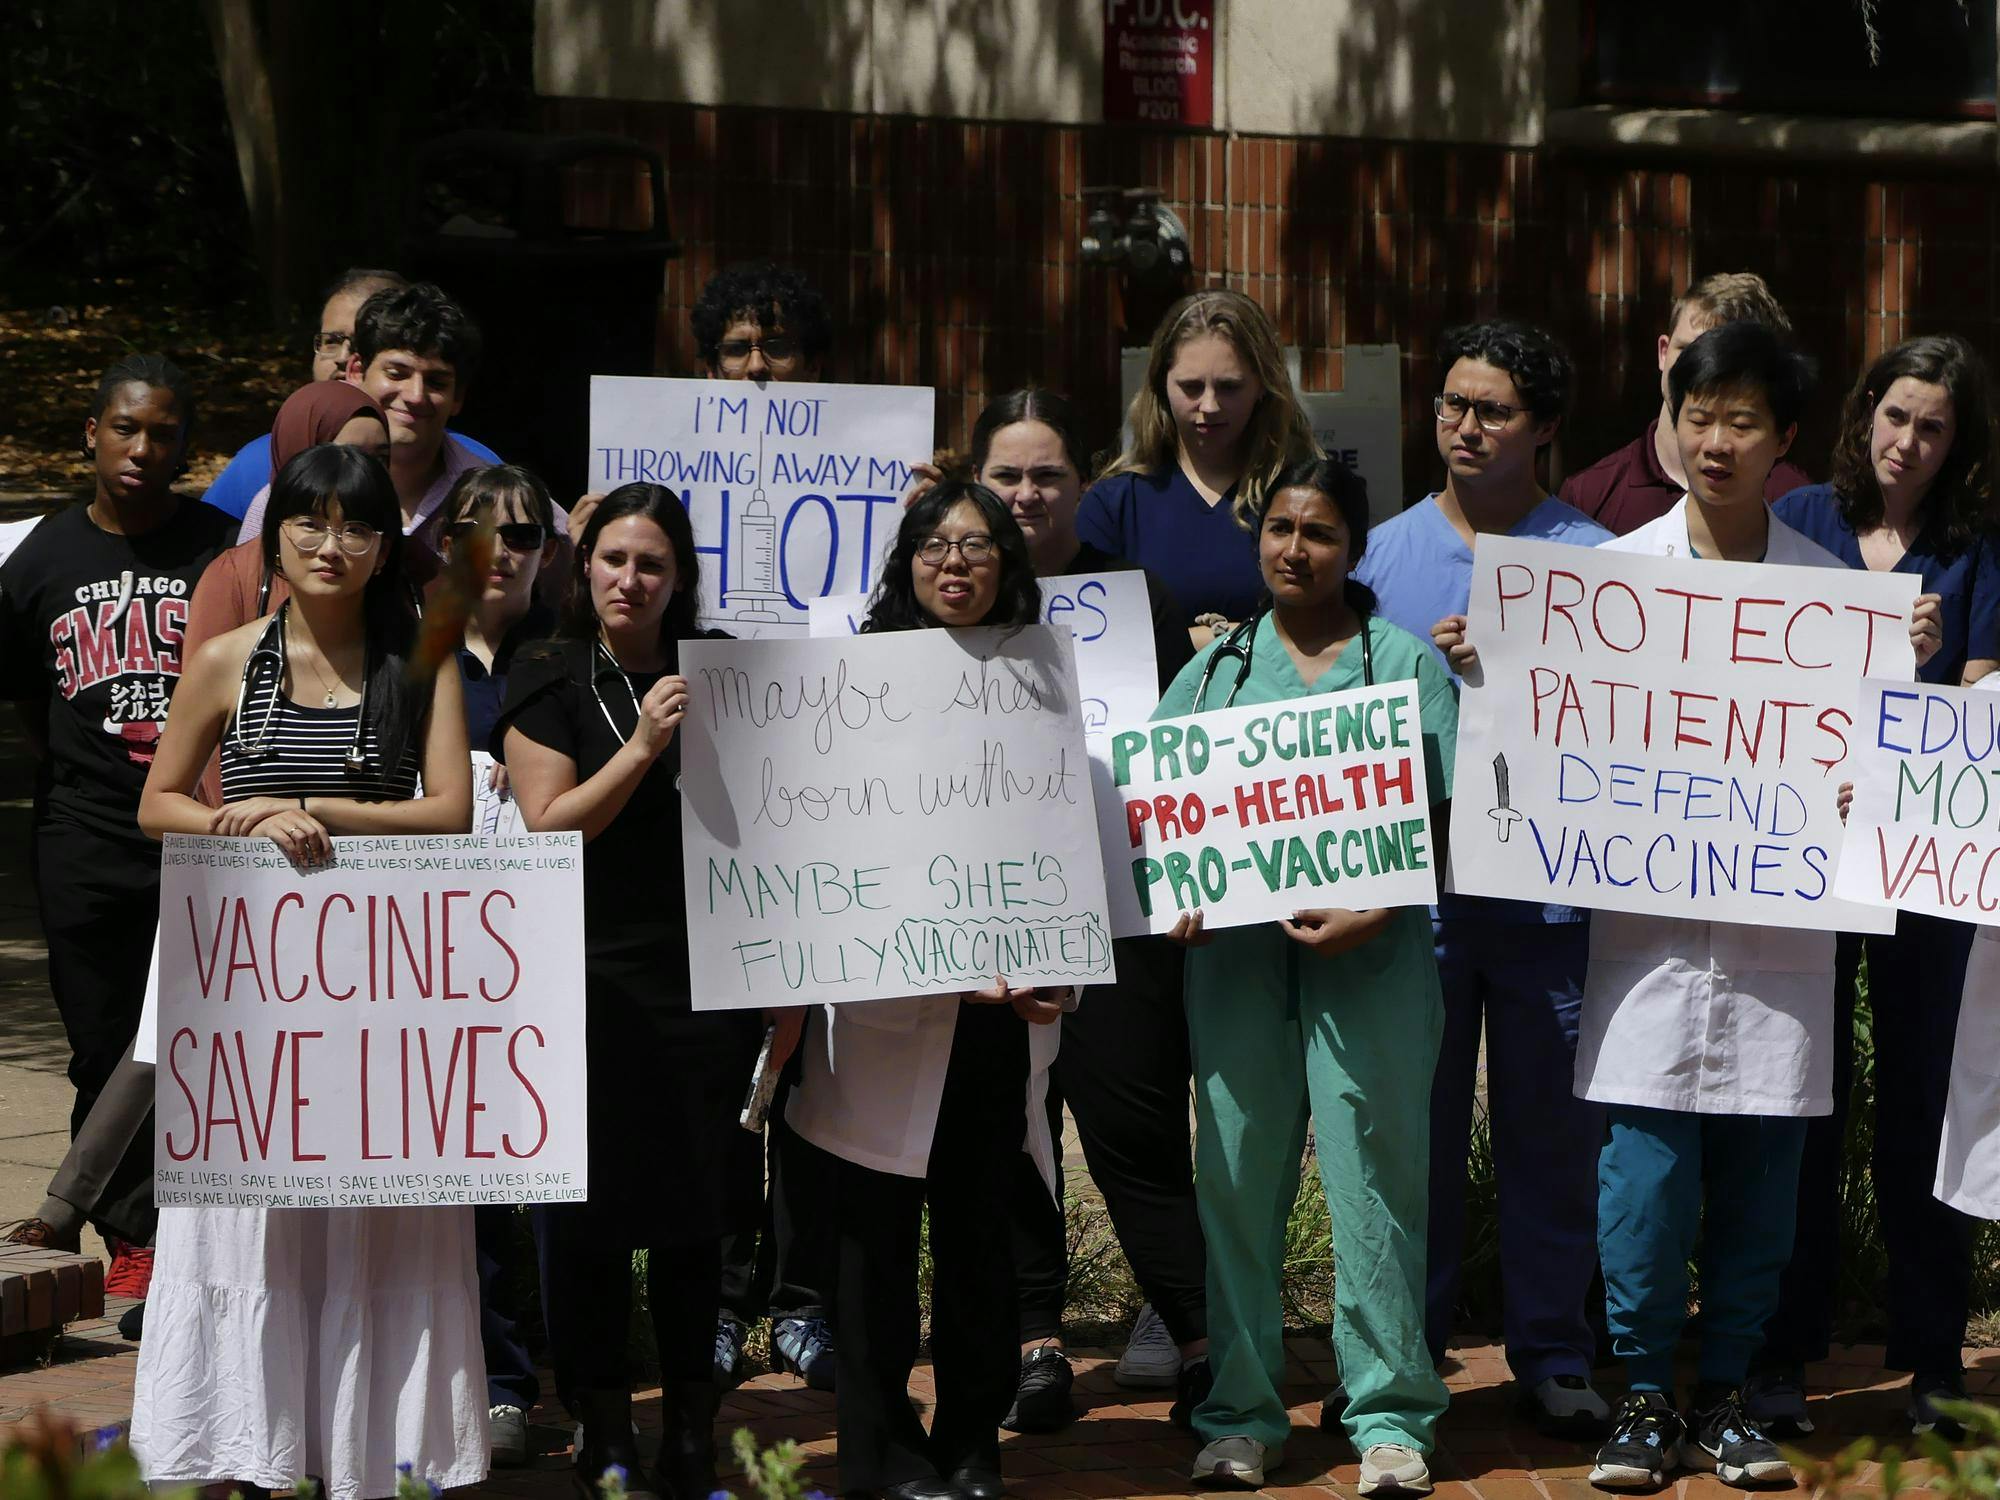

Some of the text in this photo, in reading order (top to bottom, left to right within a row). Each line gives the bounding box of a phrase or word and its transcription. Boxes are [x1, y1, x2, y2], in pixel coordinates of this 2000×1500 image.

[1119, 50, 1197, 75] Research
[693, 396, 828, 437] I'M NOT
[596, 448, 915, 491] THROWING AWAY MY
[681, 488, 897, 612] HOT
[75, 577, 187, 604] CHIAGO
[1496, 564, 1903, 677] PROTECT
[110, 676, 166, 703] シカゴ
[939, 654, 1042, 716] she's
[1111, 695, 1411, 788] PRO-SCIENCE
[1529, 667, 1853, 778] PATIENTS
[1877, 690, 2000, 762] EDU
[753, 756, 905, 828] born
[1125, 757, 1415, 849] PRO-HEALTH
[1558, 753, 1807, 836] DEFEND
[164, 835, 187, 849] SAVE
[187, 837, 216, 850] LIVES!
[216, 840, 241, 853] SAVE
[362, 839, 401, 853] SAVE
[404, 838, 449, 851] LIVES!
[452, 838, 489, 850] SAVE
[495, 835, 541, 849] LIVES!
[545, 834, 577, 847] SAVE
[164, 853, 190, 866] LIVES!
[191, 854, 217, 867] SAVE
[218, 855, 250, 868] LIVES!
[254, 856, 288, 869] SAVE
[332, 857, 364, 871] SAVE
[367, 857, 412, 871] LIVES!
[414, 857, 450, 871] SAVE
[454, 857, 498, 872] LIVES!
[499, 859, 533, 871] SAVE
[536, 857, 576, 871] LIVES!
[1131, 818, 1428, 918] PRO-VACCINE
[1527, 817, 1829, 901] VACCINES
[708, 850, 1070, 920] MAYBE SHE'S
[186, 889, 521, 1002] VACCINES
[731, 921, 1110, 992] FULLY VACCINATED
[166, 1024, 549, 1162] SAVE LIVES
[157, 1169, 572, 1192] SAVE LIVES! SAVE LIVES! SAVE LIVES! SAVE LIVES! SAVE
[157, 1187, 587, 1208] LIVES! SAVE LIVES! SAVE LIVES! SAVE LIVES! SAVE LIVES! SAVE LIVES!
